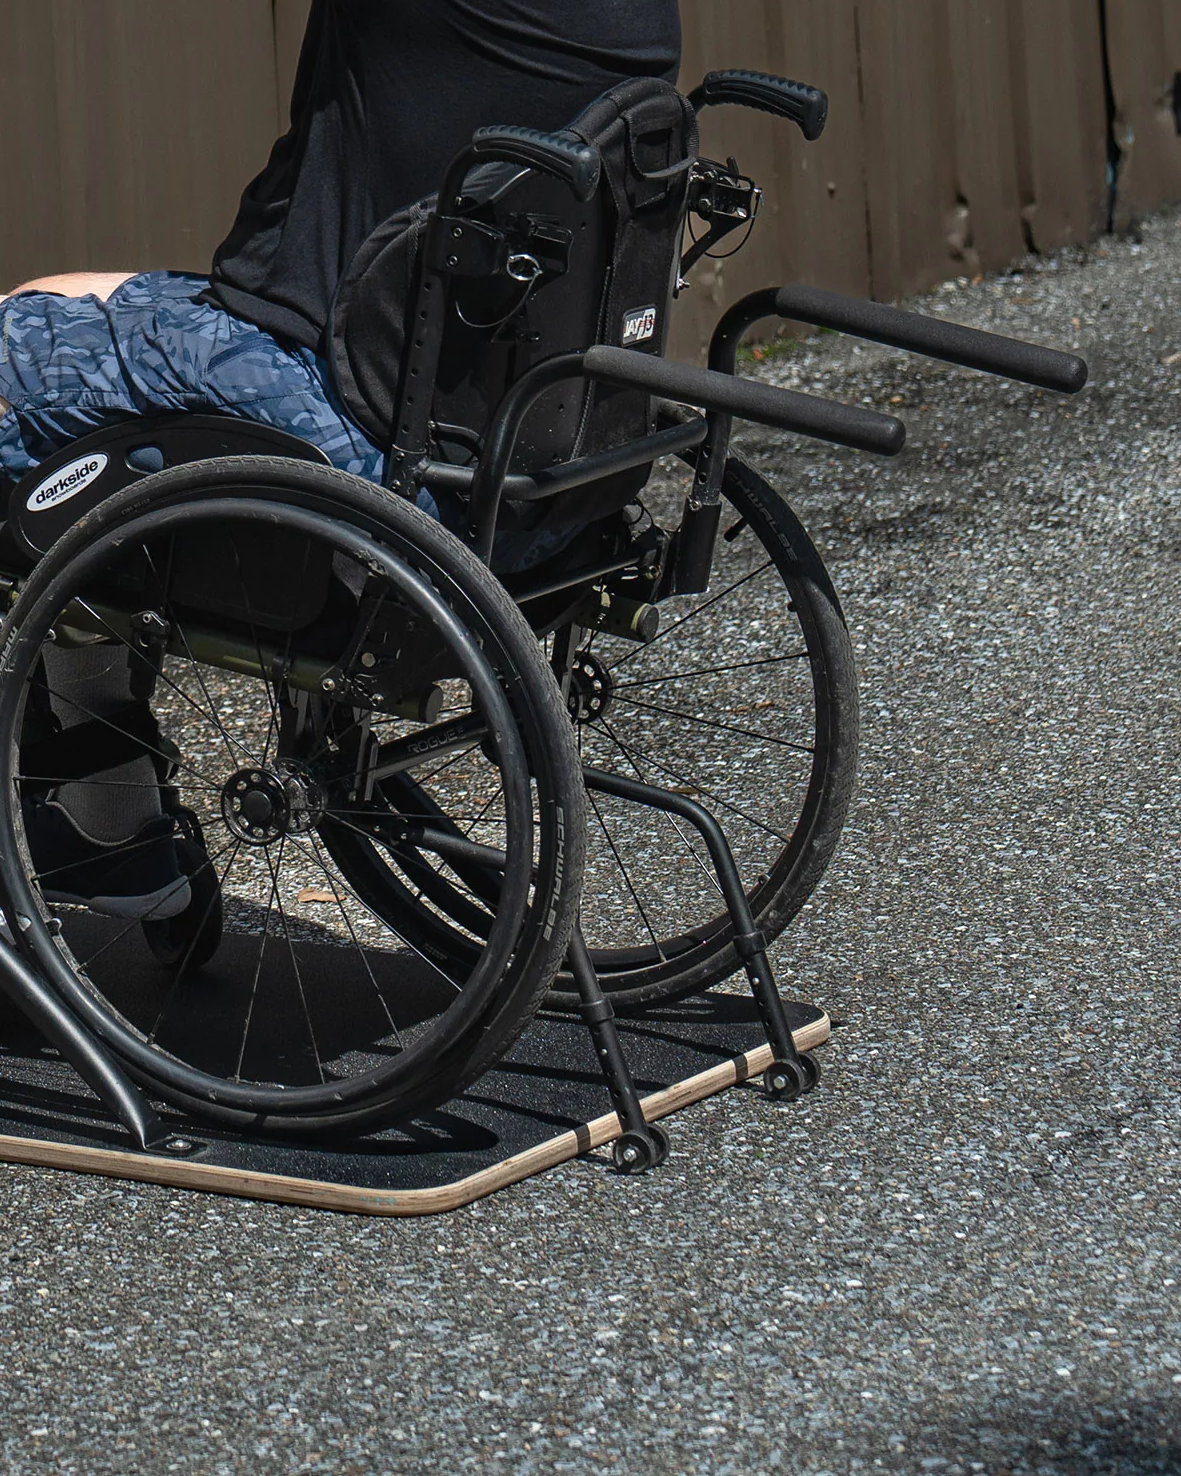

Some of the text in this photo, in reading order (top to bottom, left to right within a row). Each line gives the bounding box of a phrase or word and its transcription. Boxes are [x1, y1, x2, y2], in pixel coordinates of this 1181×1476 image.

[35, 460, 99, 504] darkside
[407, 727, 458, 753] ROGUE
[543, 806, 565, 942] SCHWALBE
